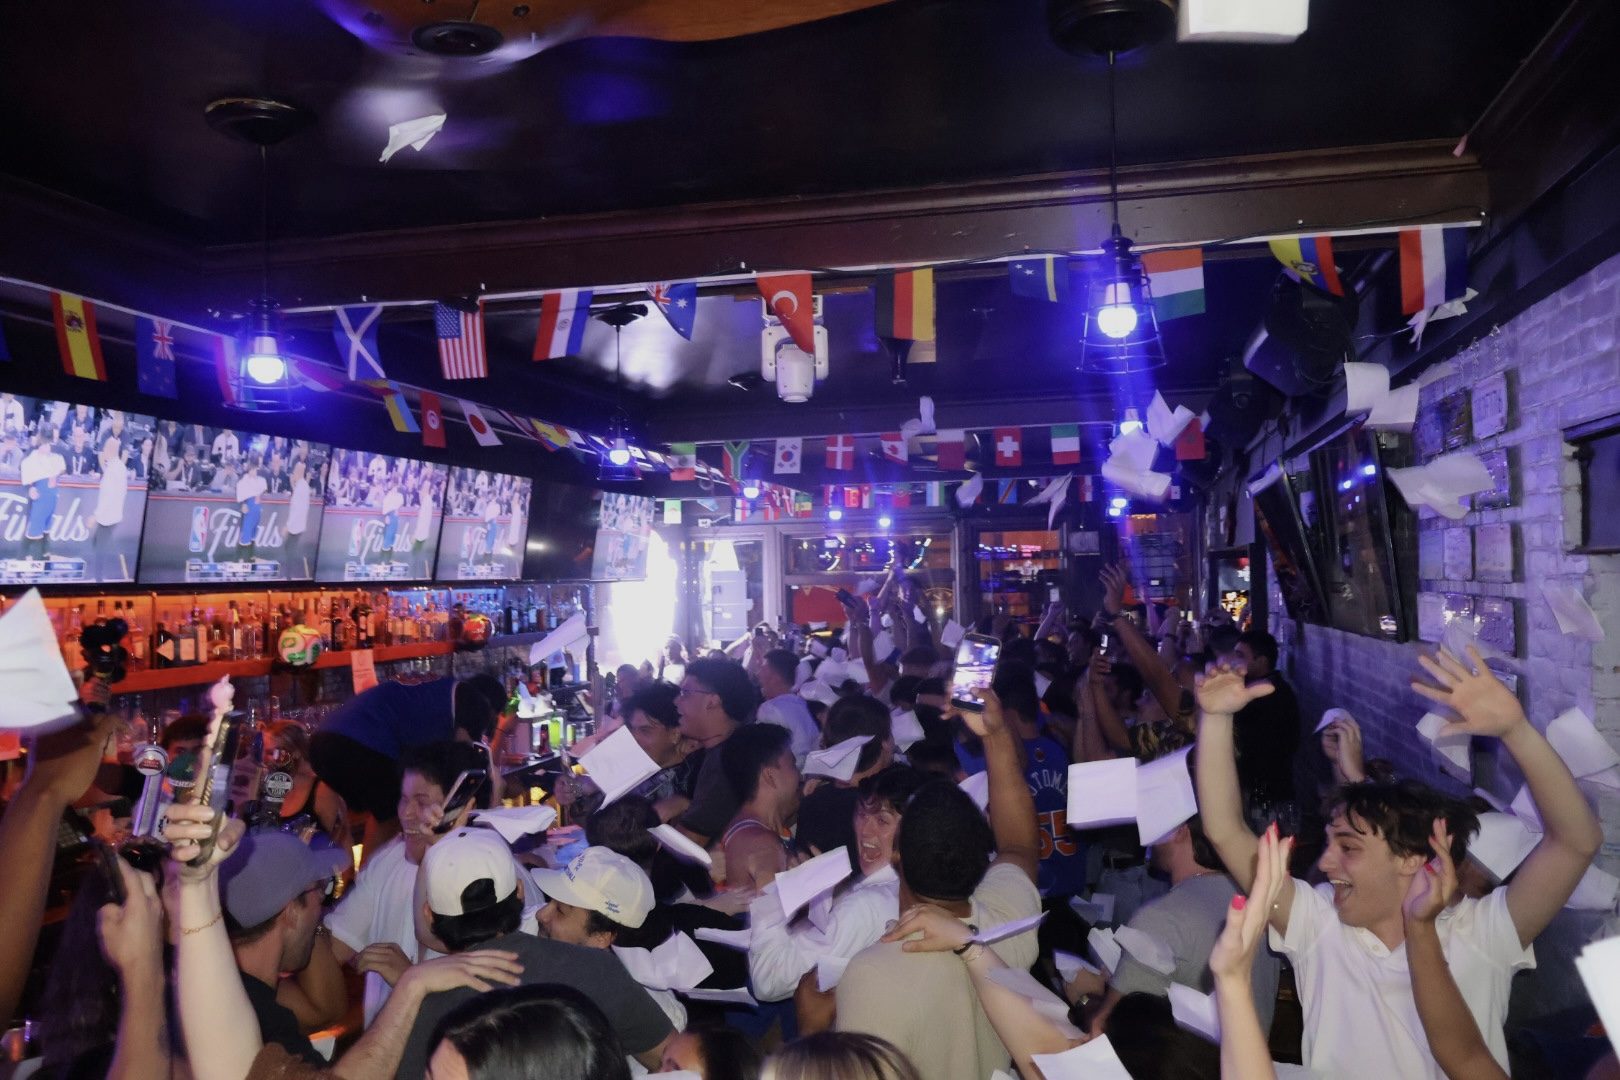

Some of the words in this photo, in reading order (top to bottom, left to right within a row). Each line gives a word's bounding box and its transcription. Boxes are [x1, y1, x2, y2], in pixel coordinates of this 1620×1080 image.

[0, 491, 90, 541] Fils
[207, 508, 283, 563] Fils
[360, 519, 411, 565] Fils
